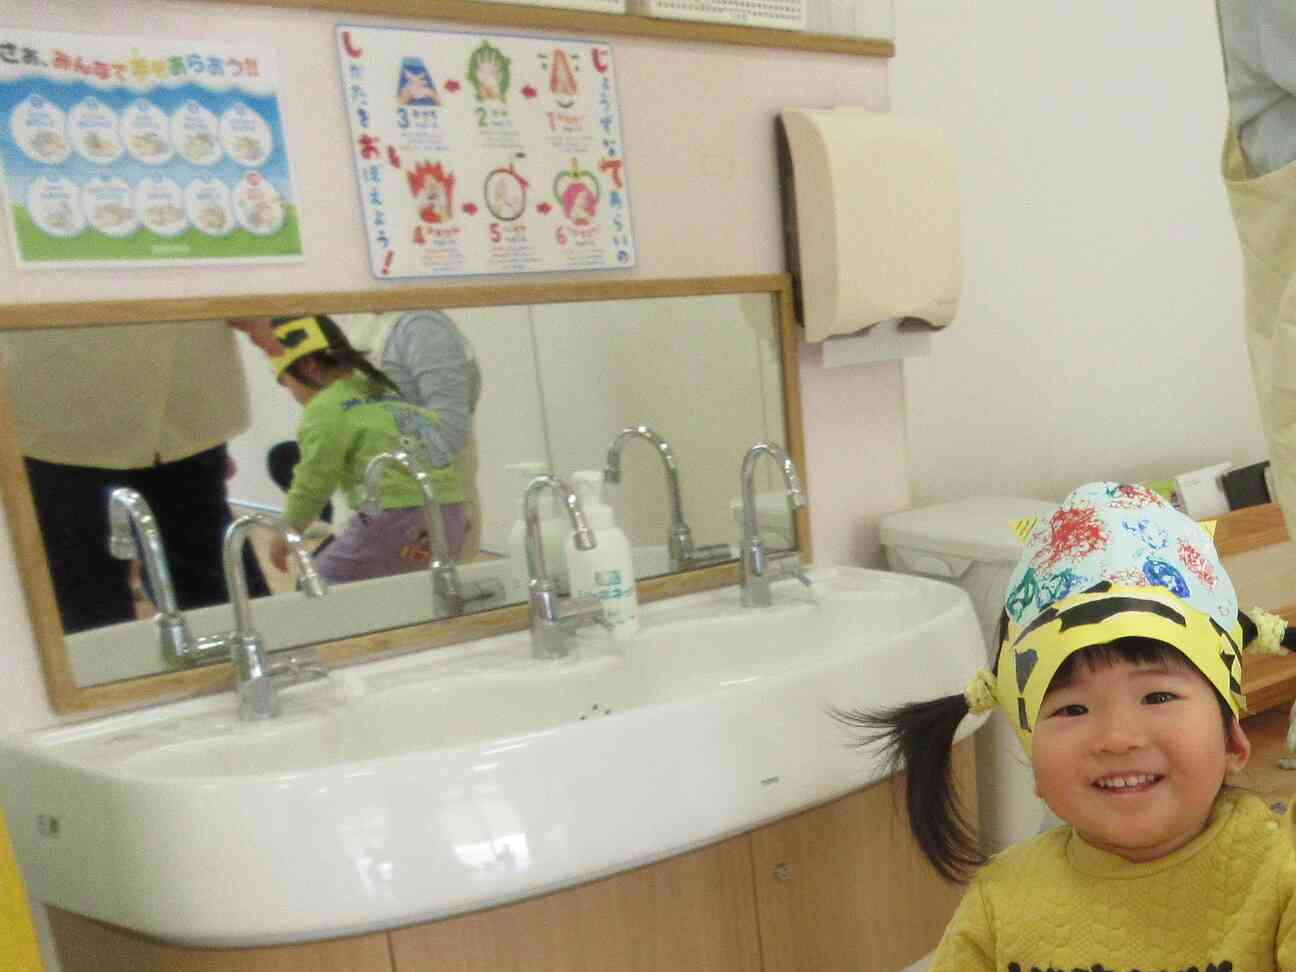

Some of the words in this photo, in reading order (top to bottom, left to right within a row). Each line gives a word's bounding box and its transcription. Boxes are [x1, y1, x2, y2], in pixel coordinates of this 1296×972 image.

[398, 106, 409, 129] 3
[475, 106, 489, 127] 2
[489, 223, 503, 243] 5
[554, 226, 568, 246] 6
